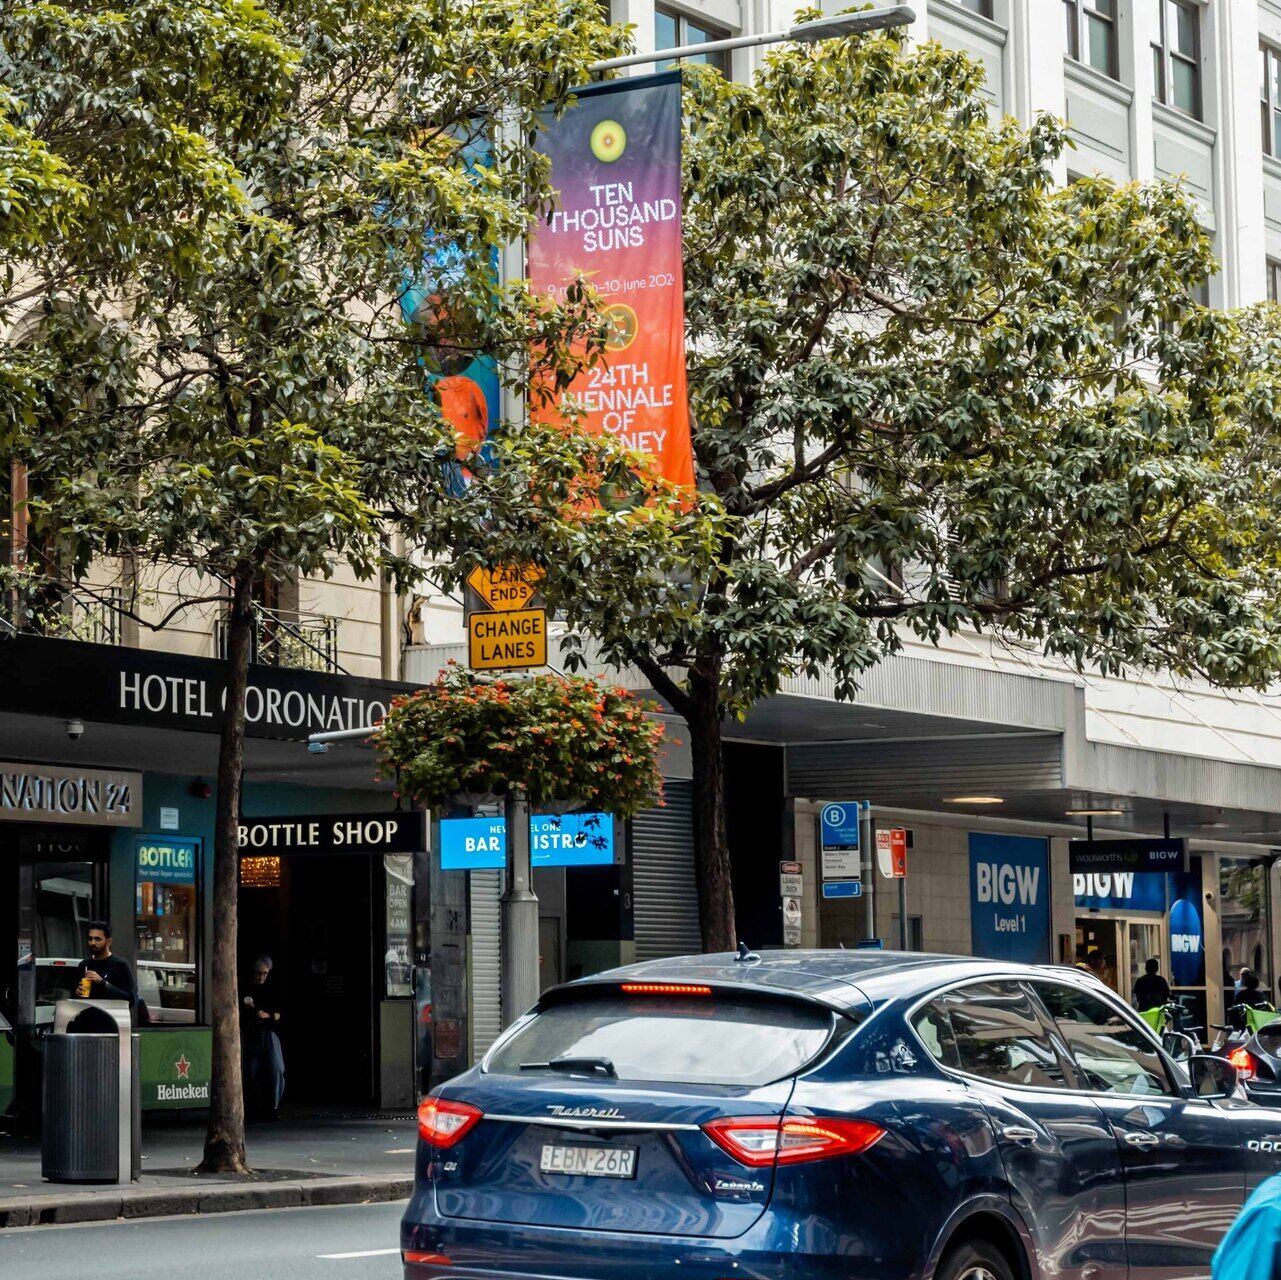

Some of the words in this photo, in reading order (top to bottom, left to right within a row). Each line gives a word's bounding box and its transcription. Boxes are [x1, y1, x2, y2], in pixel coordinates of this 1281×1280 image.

[590, 181, 633, 206] TEN
[545, 198, 677, 233] THOUSAND
[583, 225, 644, 252] SUNS
[547, 284, 556, 296] 9
[623, 278, 646, 293] june
[587, 362, 648, 388] 24TH
[602, 410, 636, 433] OF
[490, 586, 527, 602] ENDS
[474, 618, 541, 638] CHANGE
[481, 641, 535, 661] LANES
[119, 671, 213, 717] HOTEL
[221, 685, 396, 731] ORONATIO
[106, 782, 131, 813] 24
[830, 810, 840, 822] B
[237, 822, 320, 847] BOTTLE
[332, 820, 399, 845] SHOP
[465, 837, 501, 852] BAR
[533, 833, 588, 849] ISTRO
[1075, 853, 1123, 863] woolworths
[389, 885, 407, 897] BAR
[852, 883, 859, 895] J
[389, 899, 408, 908] OPEN
[994, 913, 1019, 933] Level
[1020, 915, 1026, 932] 1
[157, 1083, 209, 1101] Heineken
[546, 1105, 625, 1119] Maserati
